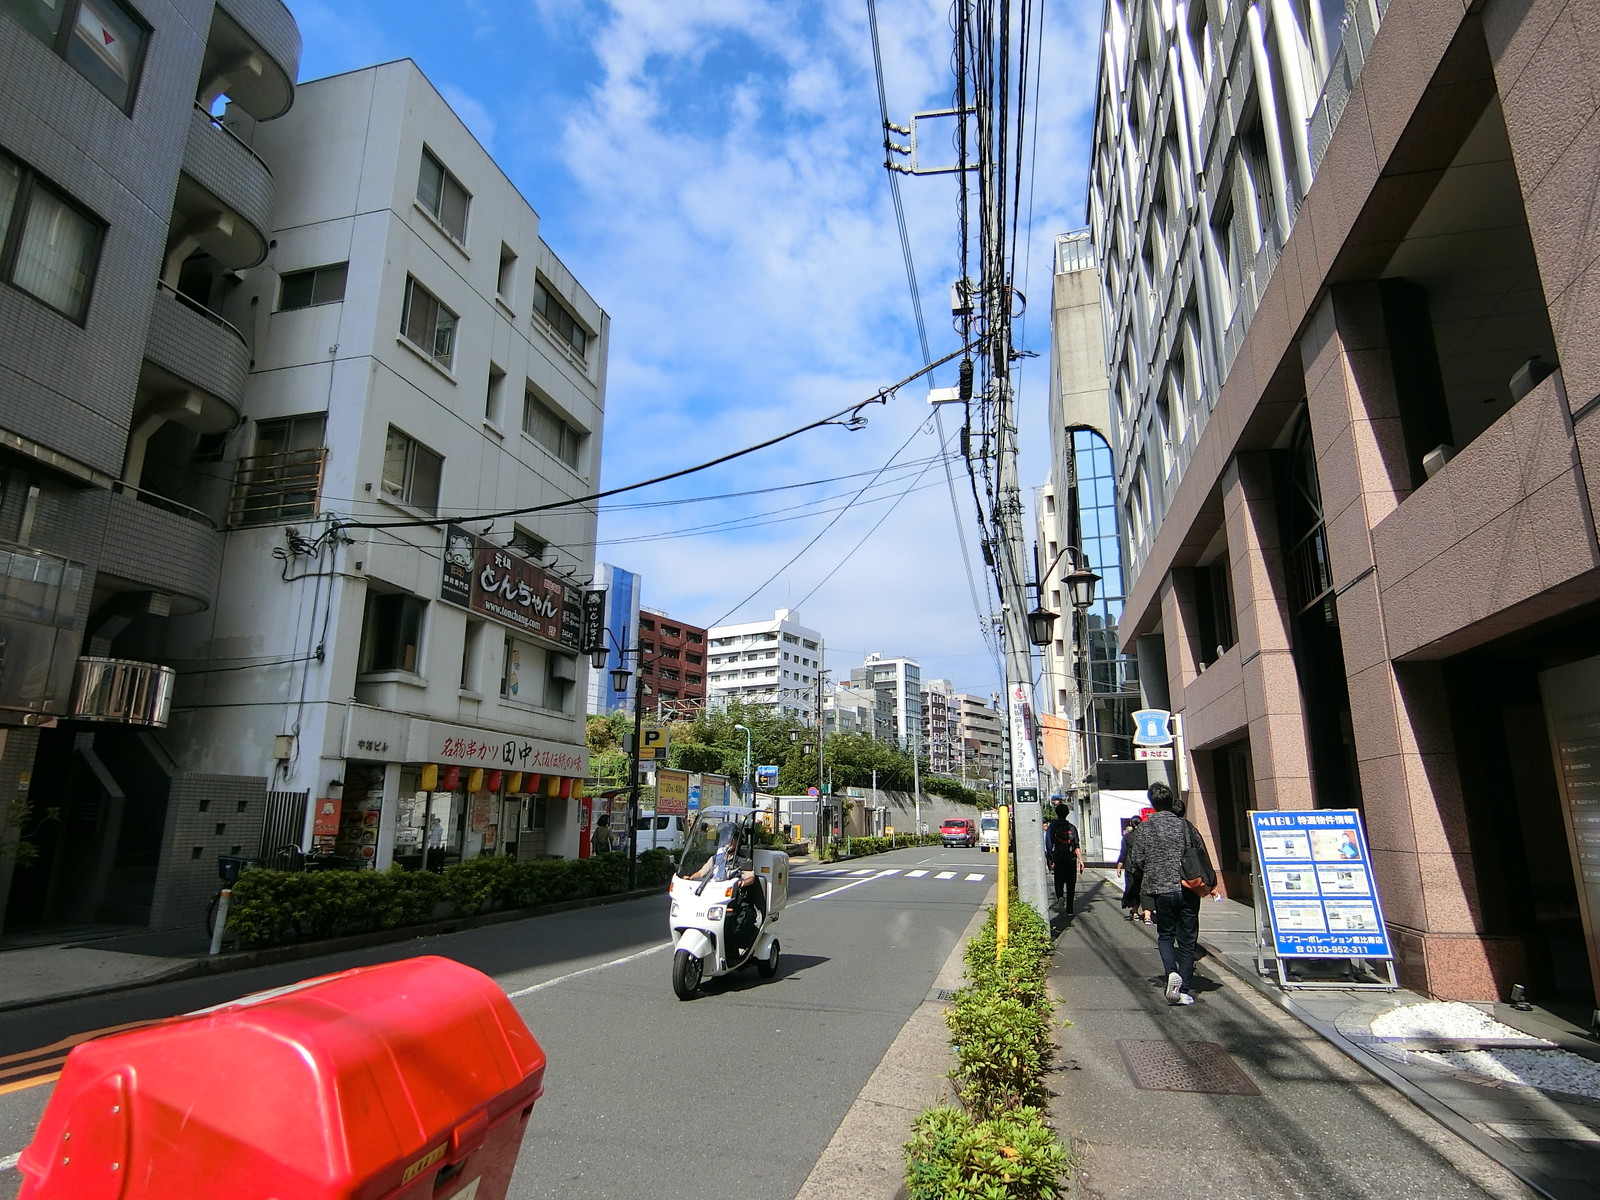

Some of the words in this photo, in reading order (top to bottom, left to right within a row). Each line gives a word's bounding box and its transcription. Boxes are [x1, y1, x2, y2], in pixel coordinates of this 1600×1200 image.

[494, 552, 513, 571] 元祖
[480, 563, 559, 619] とんちゃん
[485, 600, 542, 631] www.tonchang.com
[644, 730, 661, 746] P
[440, 736, 499, 762] 名物串カツ
[502, 740, 533, 769] 田中
[531, 751, 583, 773] 大阪伝統の味
[1257, 815, 1296, 827] MIBU
[1306, 945, 1369, 954] 0120-952-311
